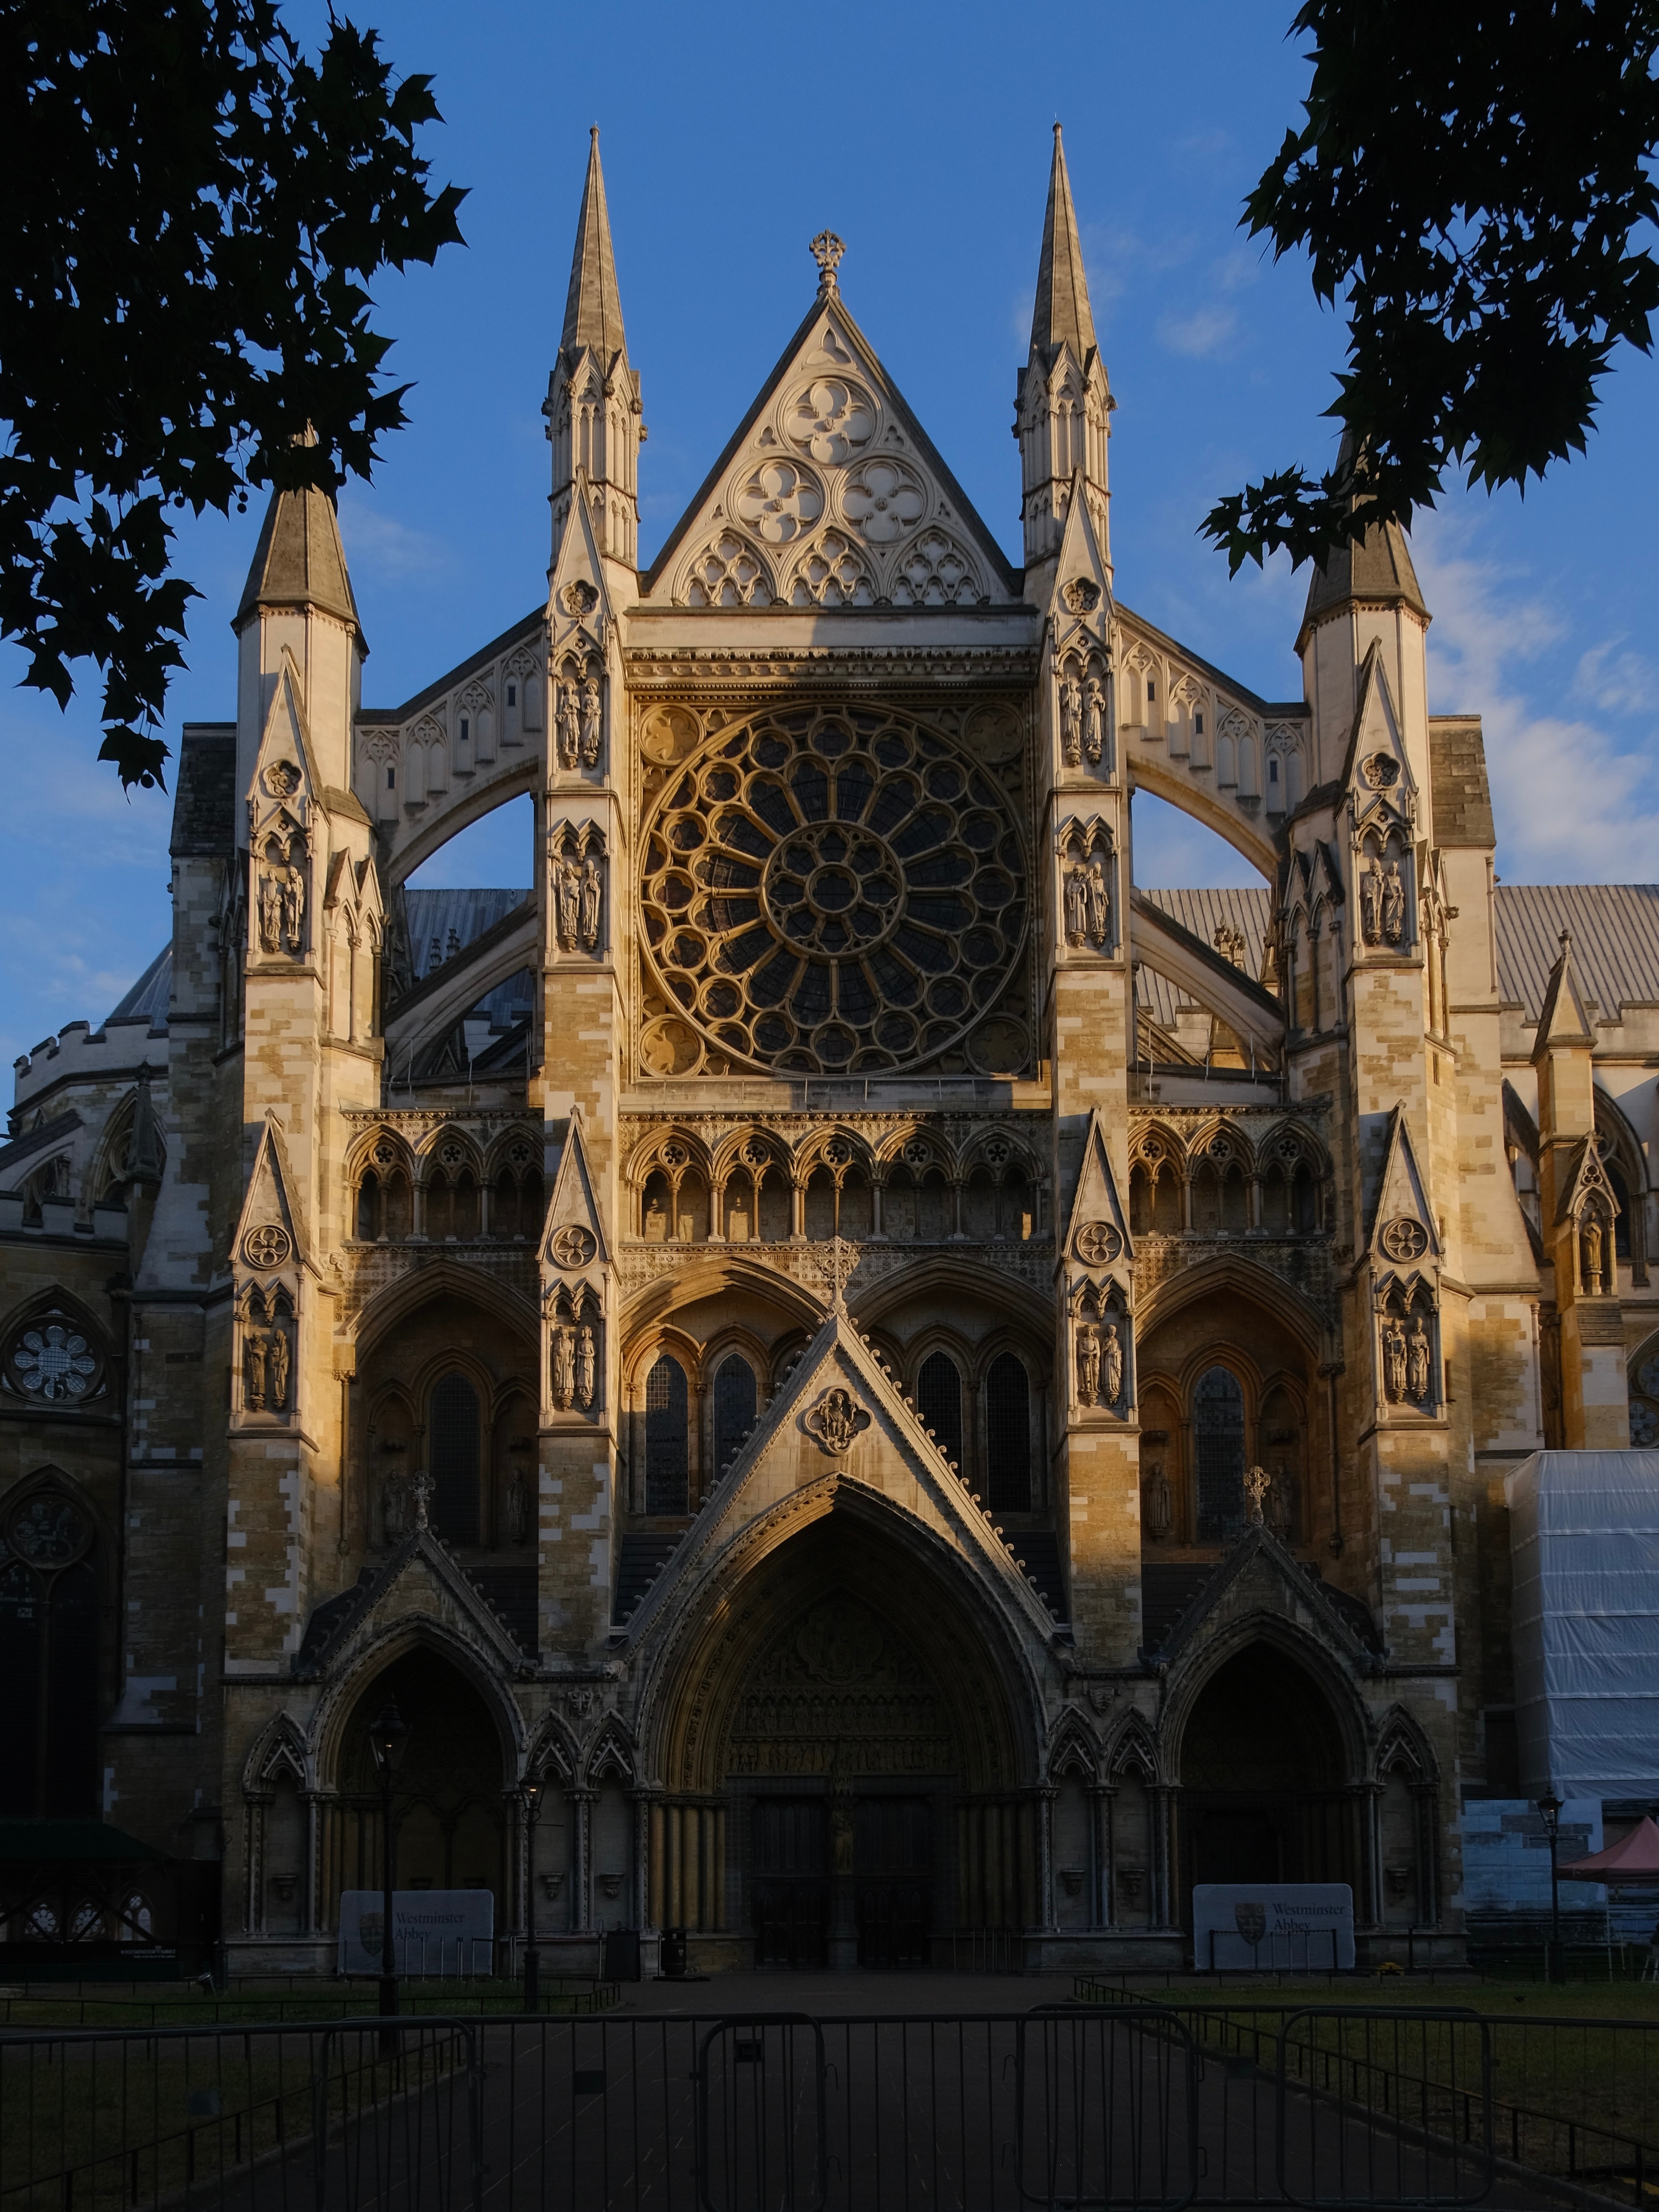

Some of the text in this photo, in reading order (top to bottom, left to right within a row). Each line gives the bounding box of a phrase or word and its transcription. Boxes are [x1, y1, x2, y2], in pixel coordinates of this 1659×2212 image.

[1272, 1902, 1345, 1915] Westminster
[396, 1911, 465, 1923] Westminster
[1274, 1918, 1311, 1930] Abbey
[395, 1927, 431, 1942] Abbey
